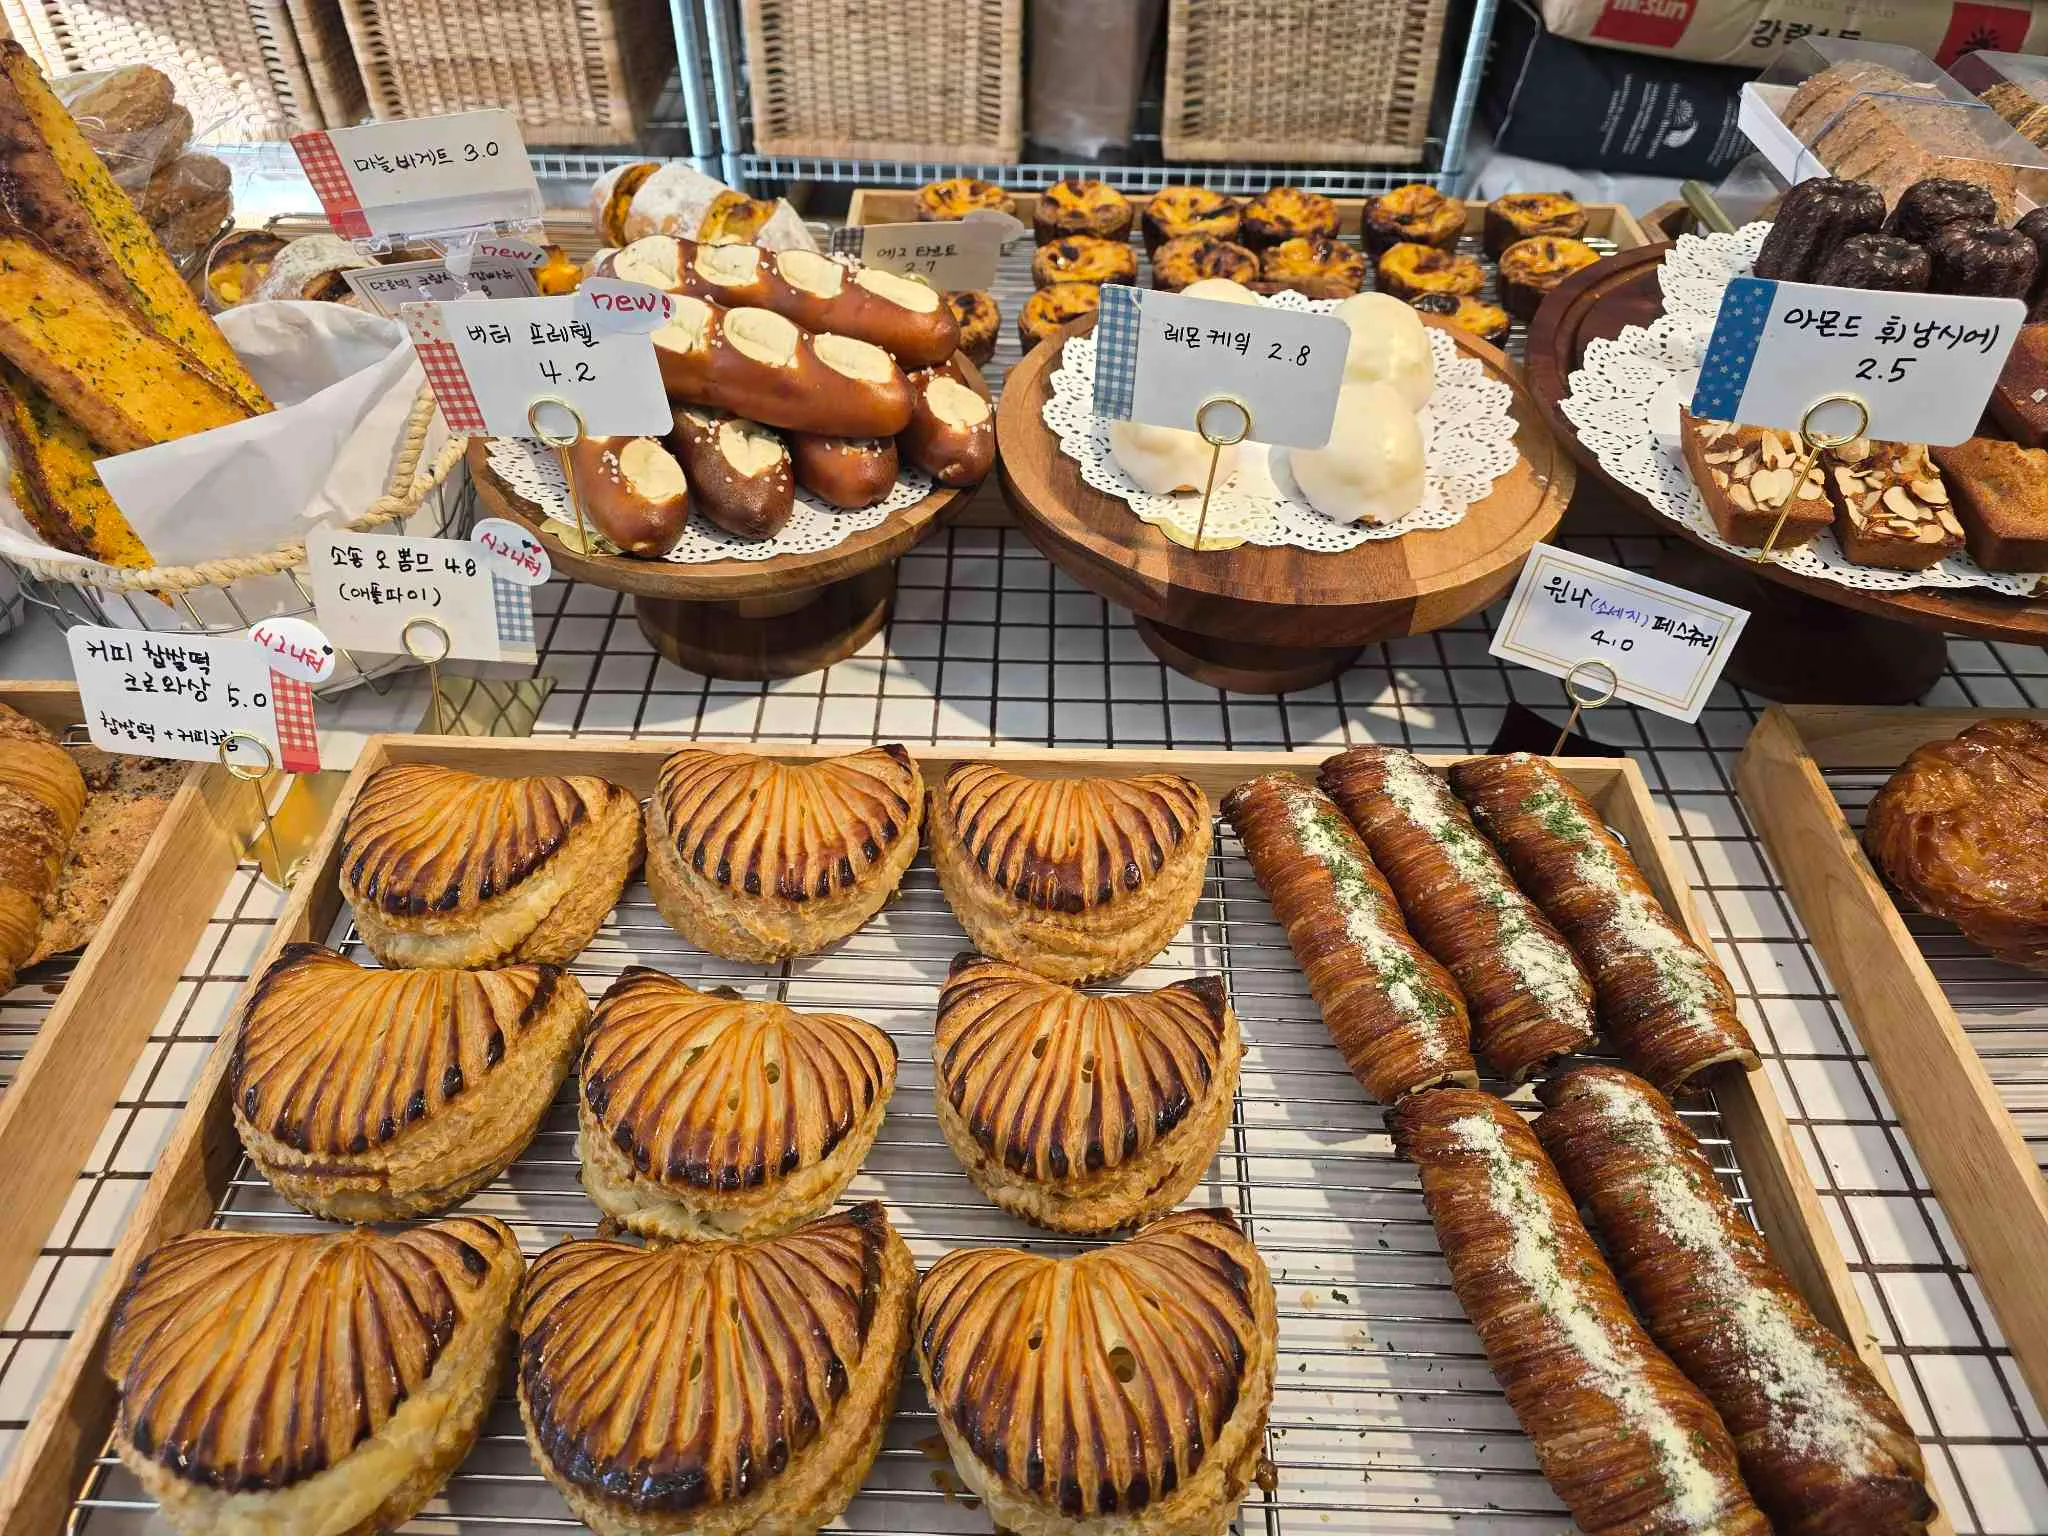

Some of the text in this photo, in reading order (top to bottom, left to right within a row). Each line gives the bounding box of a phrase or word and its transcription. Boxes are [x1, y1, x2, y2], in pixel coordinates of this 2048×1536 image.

[464, 142, 499, 163] 3.0
[876, 243, 959, 260] 에그 타르트
[904, 260, 936, 273] 2.7
[591, 292, 671, 319] new!
[466, 321, 600, 348] 버터 프레첼
[1783, 308, 2000, 353] 아몬드 휘낭시에
[1164, 323, 1201, 348] 레몬
[1268, 343, 1311, 366] 2.8
[540, 360, 596, 385] 4.2
[1855, 357, 1917, 383] 2.5
[376, 549, 390, 570] 오
[397, 547, 434, 572] 뽐므
[445, 557, 477, 577] 4.8
[1590, 629, 1634, 651] 4.0
[86, 640, 211, 675] 커피 찹쌀떡
[124, 672, 268, 708] 크로와상 5.0
[100, 711, 156, 743] 찹쌀떡
